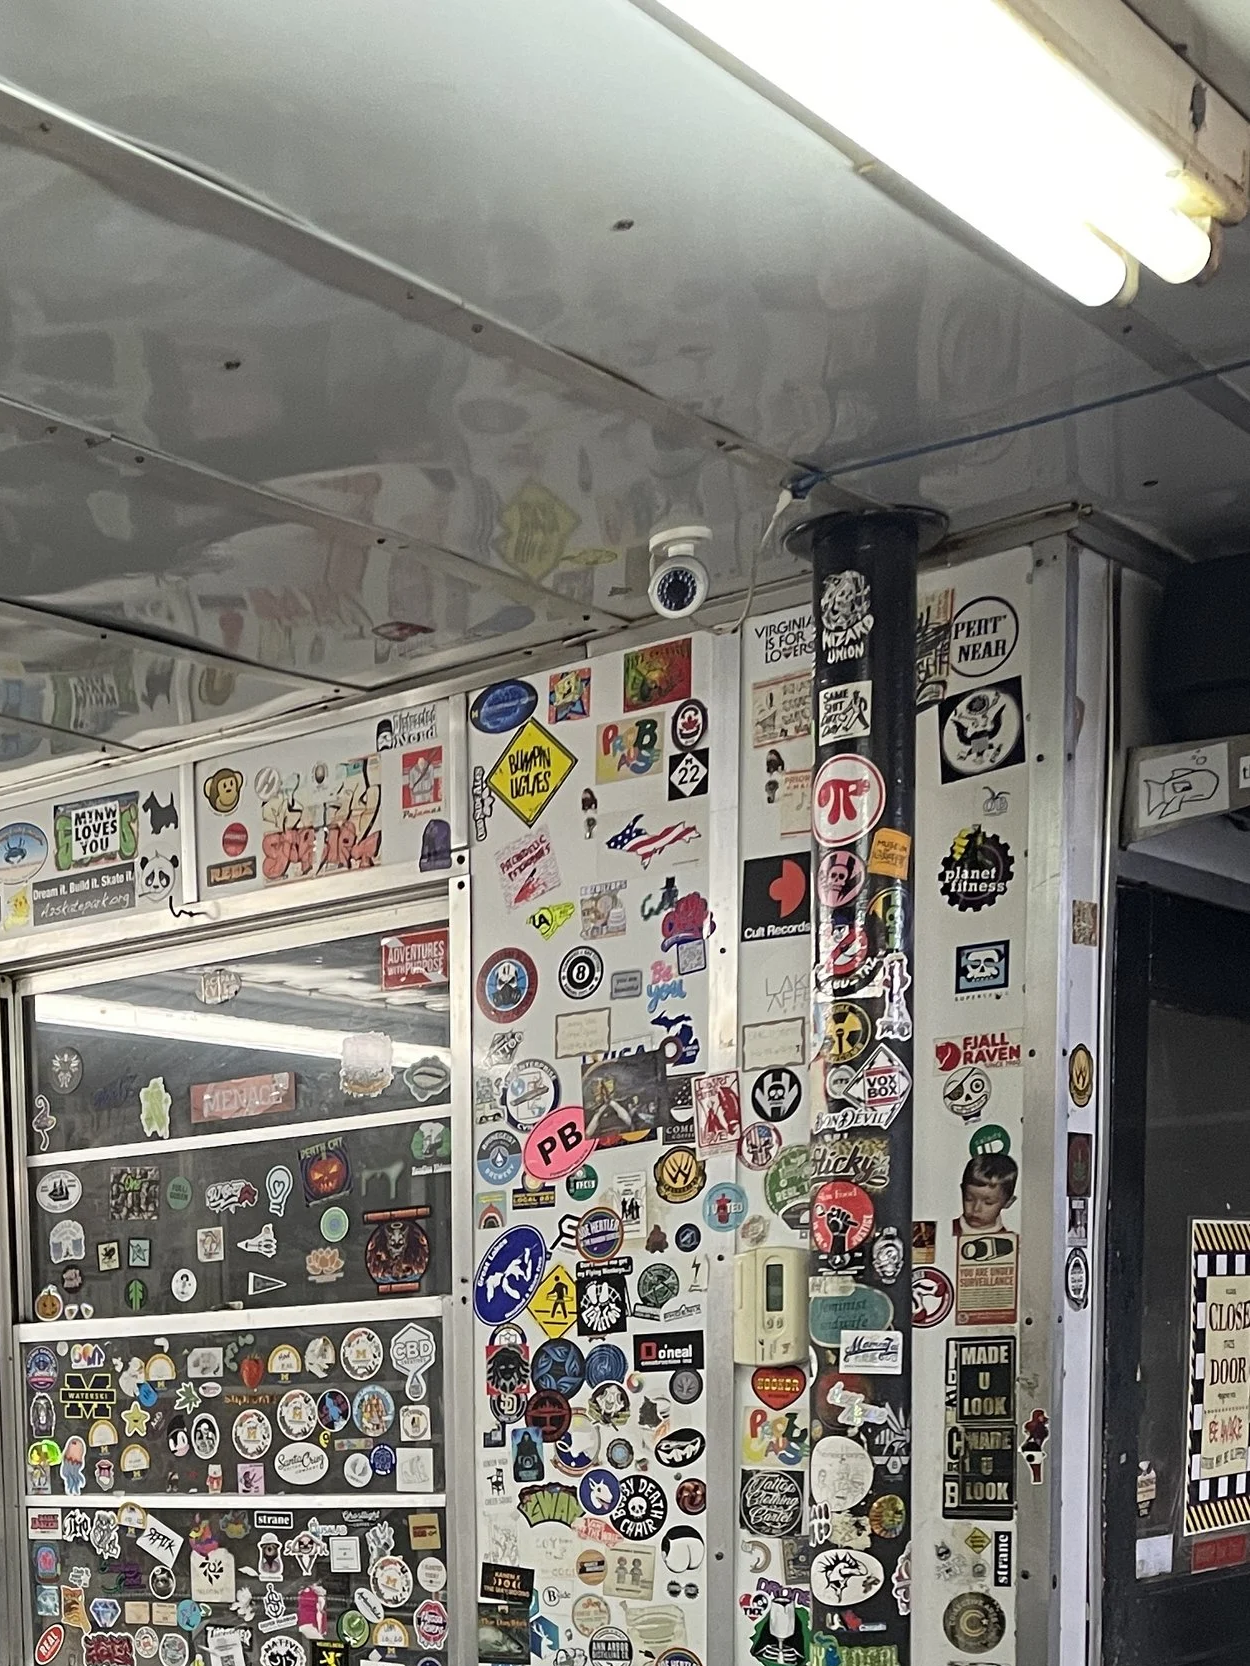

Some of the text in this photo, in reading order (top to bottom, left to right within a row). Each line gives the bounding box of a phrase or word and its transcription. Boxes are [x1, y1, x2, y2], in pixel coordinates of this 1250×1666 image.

[766, 631, 806, 650] IS FOR
[827, 644, 864, 664] UNION
[958, 640, 1006, 663] NEAR
[510, 771, 550, 799] UGLIES
[678, 765, 699, 786] 22
[74, 821, 117, 840] LOVES
[81, 839, 109, 855] YOU
[945, 866, 996, 882] planet
[33, 871, 134, 901] Dream it. Build it. Skate it.
[951, 879, 1005, 893] fitness
[744, 921, 810, 939] Cult Records
[388, 941, 444, 963] ADVENTURES
[388, 957, 443, 976] WITH PURPOSE
[576, 963, 585, 980] 8
[651, 960, 673, 979] Be
[647, 979, 687, 1013] you
[963, 1043, 1022, 1064] RAVEN
[867, 1073, 897, 1087] VOX
[867, 1085, 899, 1098] BOX
[537, 1121, 584, 1167] PB
[489, 1238, 508, 1261] Lakes
[1209, 1302, 1250, 1331] CLOSE
[393, 1340, 434, 1357] CBD
[658, 1344, 693, 1359] o'neal
[962, 1346, 1009, 1365] MADE
[978, 1371, 990, 1390] U
[1209, 1357, 1247, 1386] DOOR
[68, 1392, 108, 1400] WATERSKI
[963, 1397, 1007, 1416] LOOK
[964, 1430, 1012, 1450] MADE
[277, 1451, 324, 1471] Santa Cruz
[638, 1478, 664, 1520] DEATH
[965, 1481, 1009, 1501] LOOK
[258, 1515, 291, 1525] strane
[751, 1506, 793, 1525] Cartel
[620, 1519, 656, 1538] CHAIR
[997, 1534, 1009, 1584] strane
[39, 1632, 58, 1655] REAL
[265, 1639, 300, 1654] NATIVE
[592, 1642, 630, 1653] ANN ARBOR
